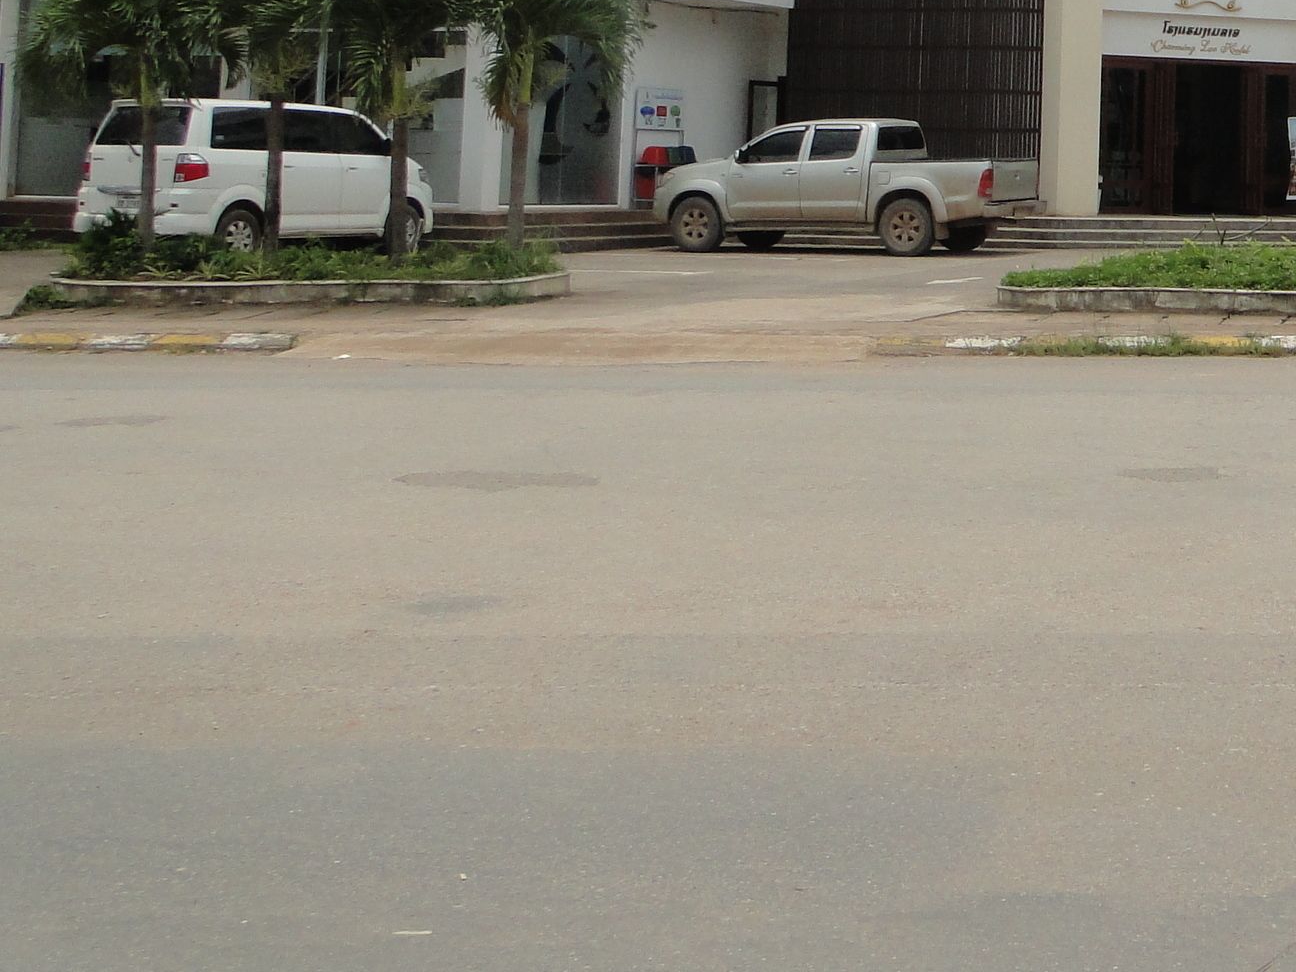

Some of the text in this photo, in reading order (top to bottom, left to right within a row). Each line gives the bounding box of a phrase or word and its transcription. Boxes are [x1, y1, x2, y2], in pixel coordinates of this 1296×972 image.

[1151, 39, 1253, 56] Charming Lao Hotel
